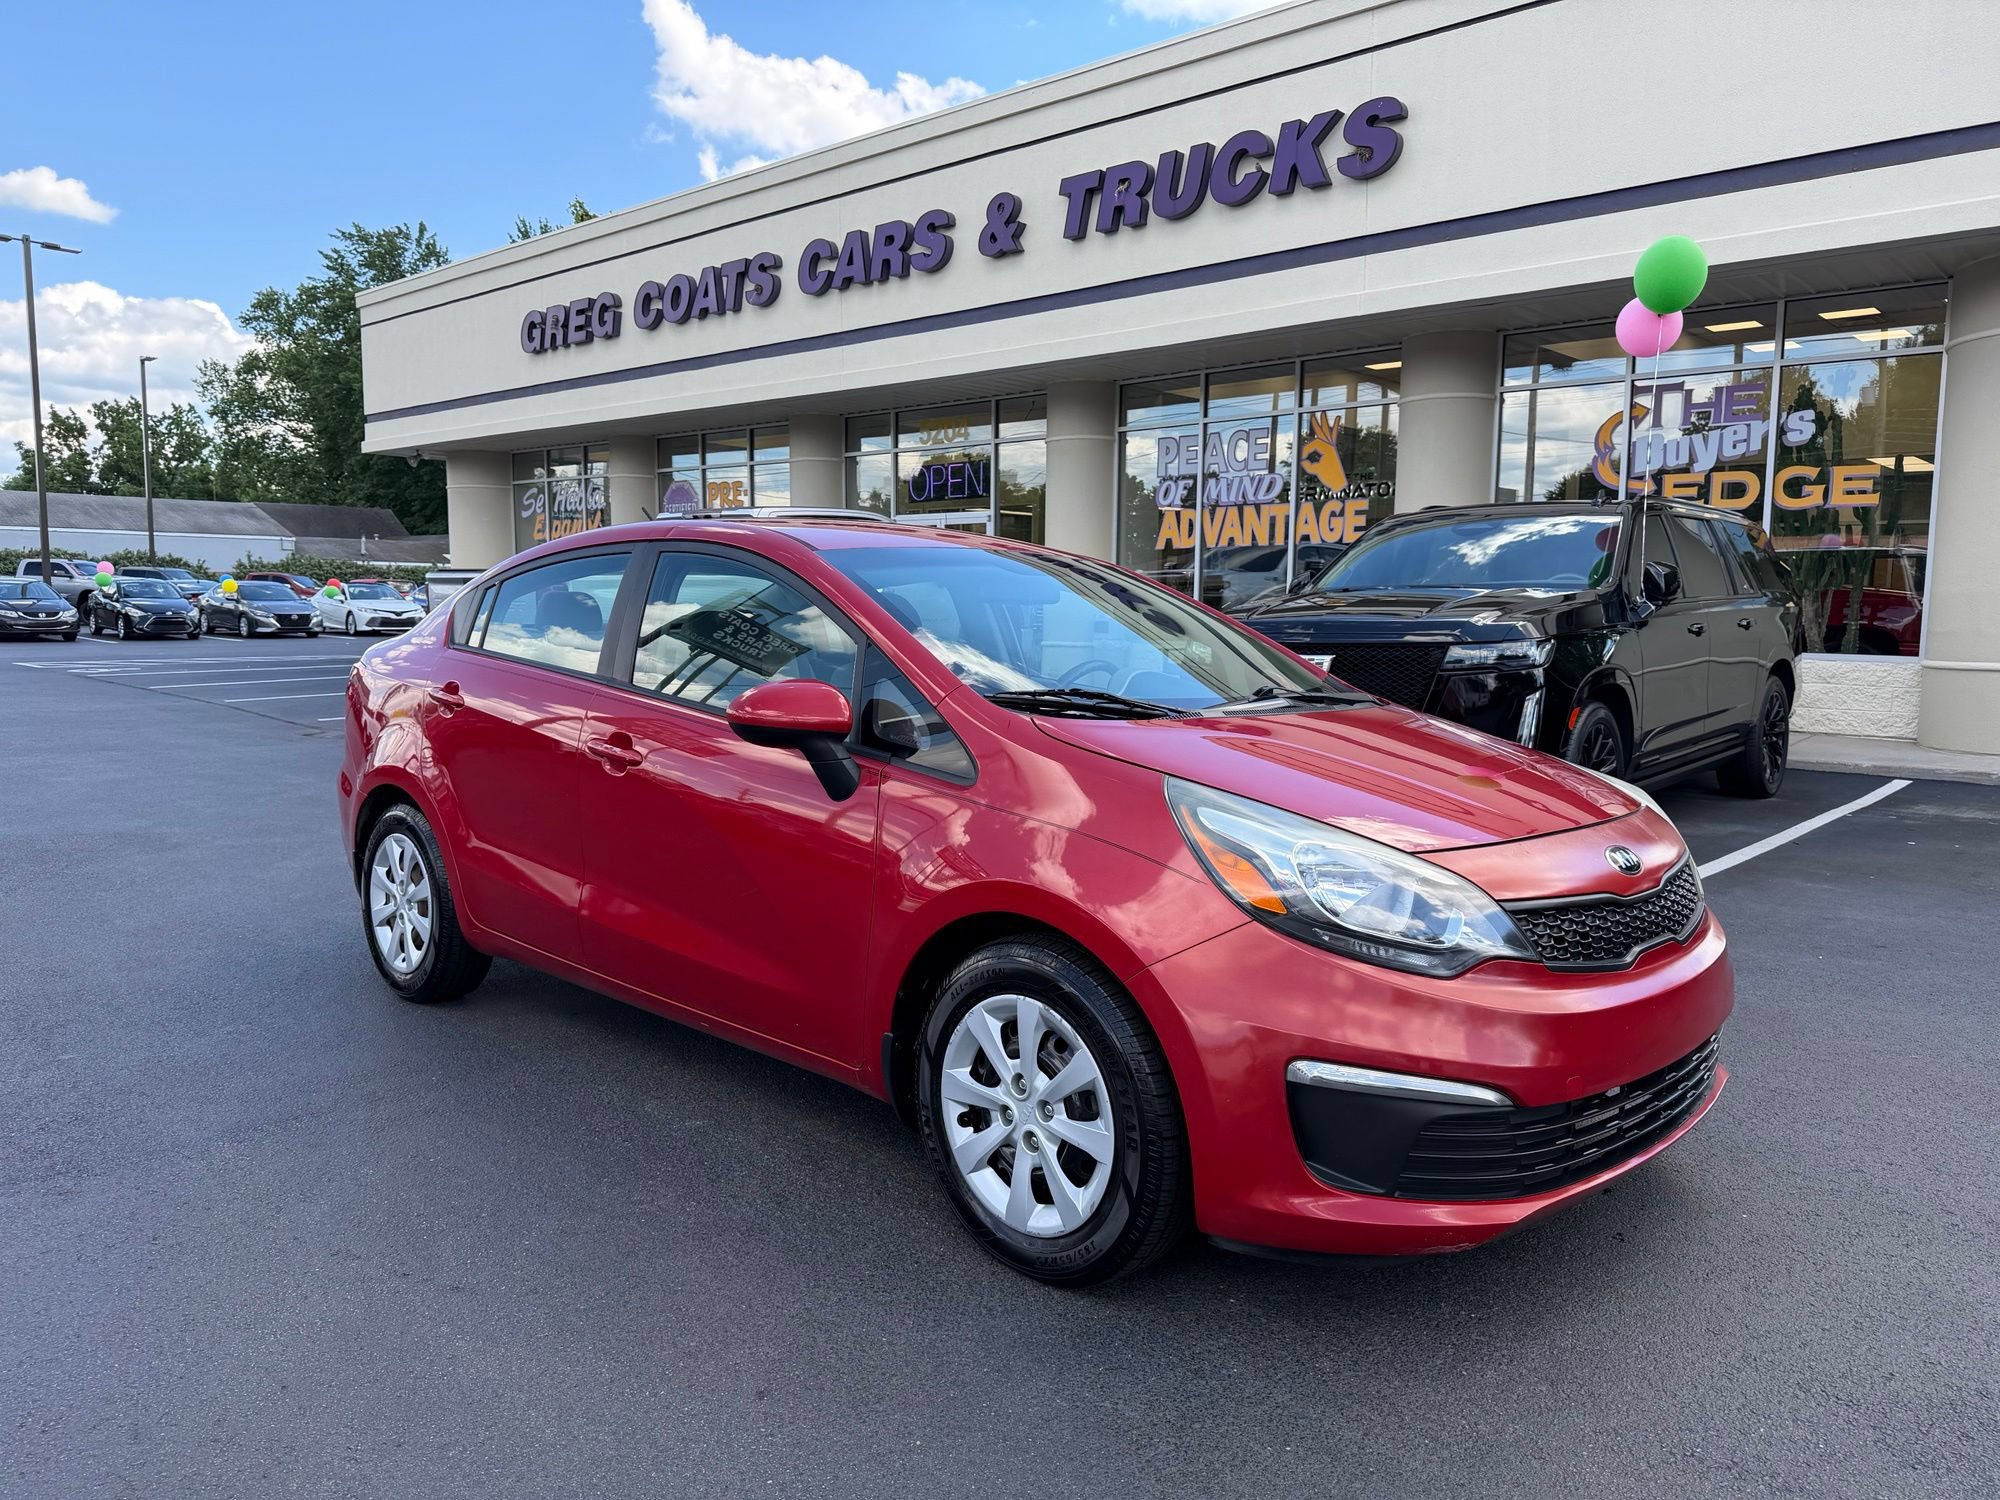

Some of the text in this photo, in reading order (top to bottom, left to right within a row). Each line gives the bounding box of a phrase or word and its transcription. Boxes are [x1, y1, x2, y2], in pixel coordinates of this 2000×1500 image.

[520, 96, 1409, 354] GREG COATS CARS & TRUCKS
[1633, 381, 1766, 428] THE
[919, 416, 970, 445] 5204
[1156, 427, 1270, 477] PEACE
[707, 480, 749, 509] PRE-
[909, 461, 984, 501] OPEN
[1155, 473, 1284, 507] OF MIND
[1662, 464, 1881, 511] EDGE
[521, 487, 545, 518] Se
[1155, 499, 1370, 551] ADVANTAGE
[950, 967, 1006, 1002] ALL-SEASON
